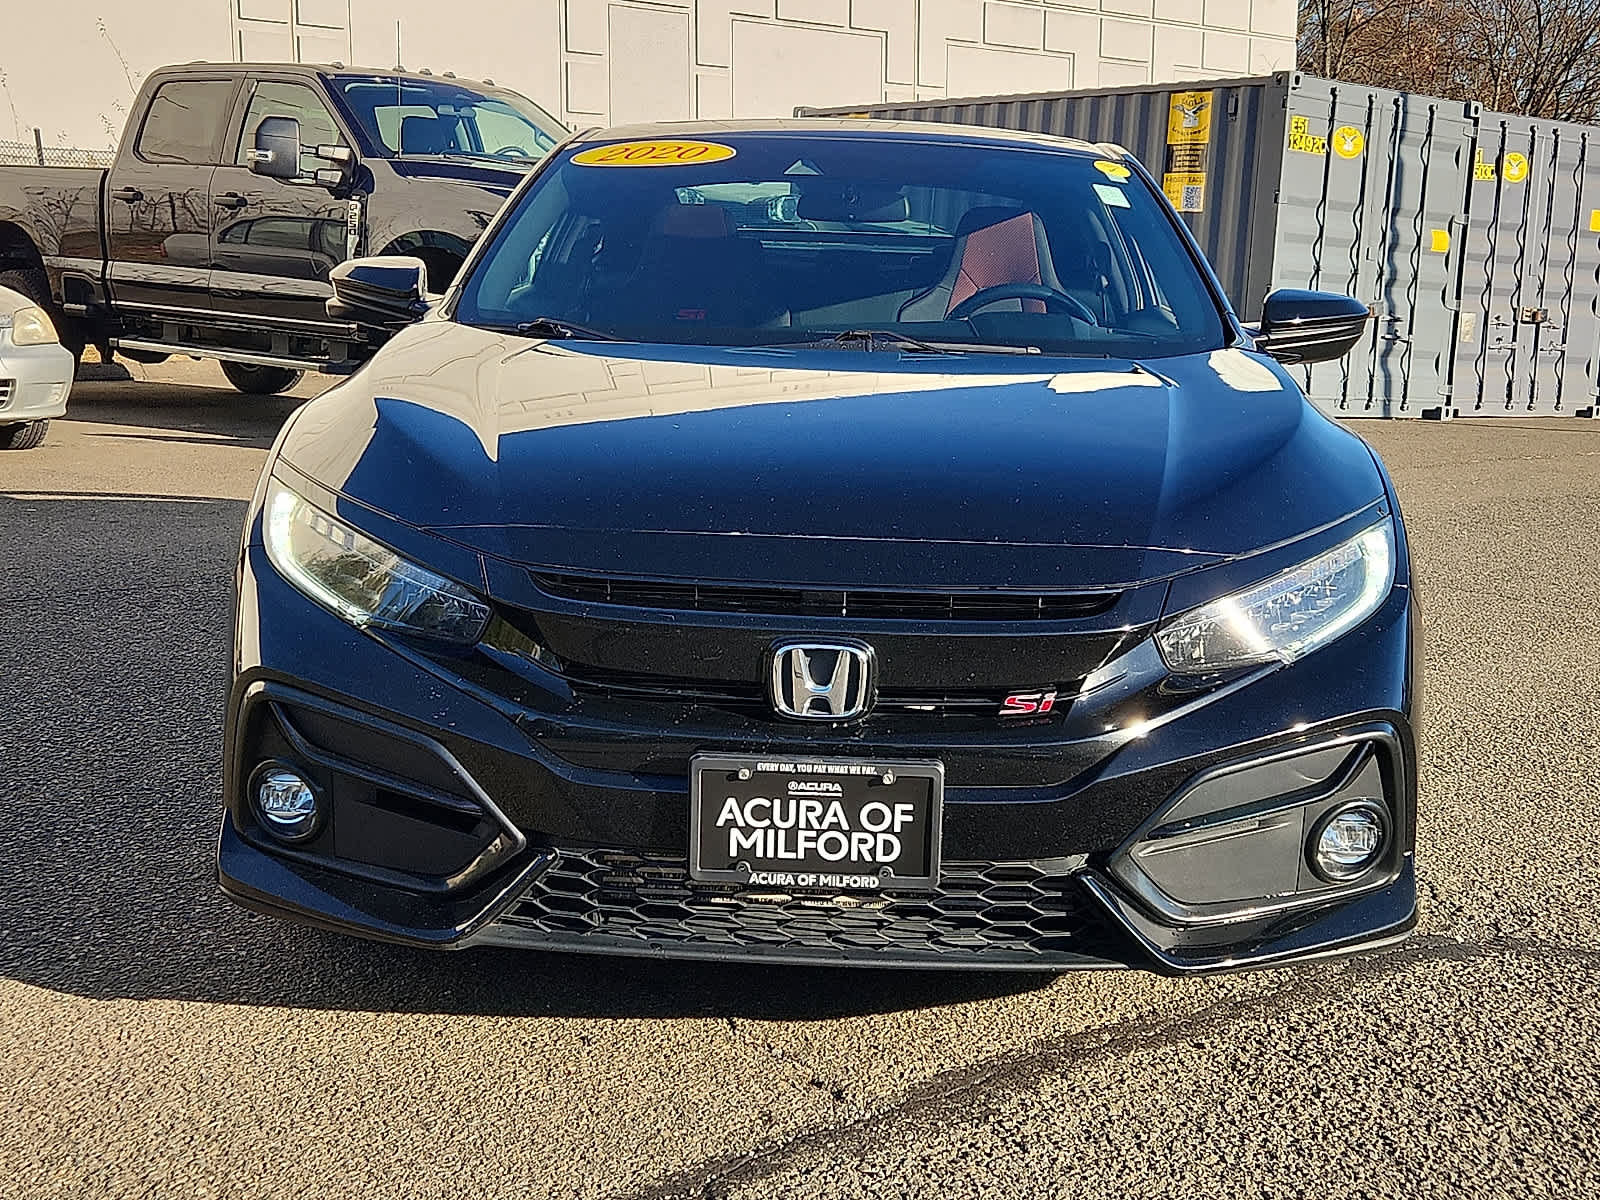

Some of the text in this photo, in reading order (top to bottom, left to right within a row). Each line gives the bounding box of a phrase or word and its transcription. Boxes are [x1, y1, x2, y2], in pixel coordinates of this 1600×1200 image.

[596, 146, 709, 162] 2020
[999, 691, 1057, 715] Si
[757, 762, 878, 775] EVERY DAY, YOU PAY WHAT WE PAY.
[798, 782, 842, 792] ACURA
[716, 797, 914, 833] ACURA OF
[729, 827, 901, 863] MILFORD
[749, 872, 880, 889] ACURA OF MILFORD
